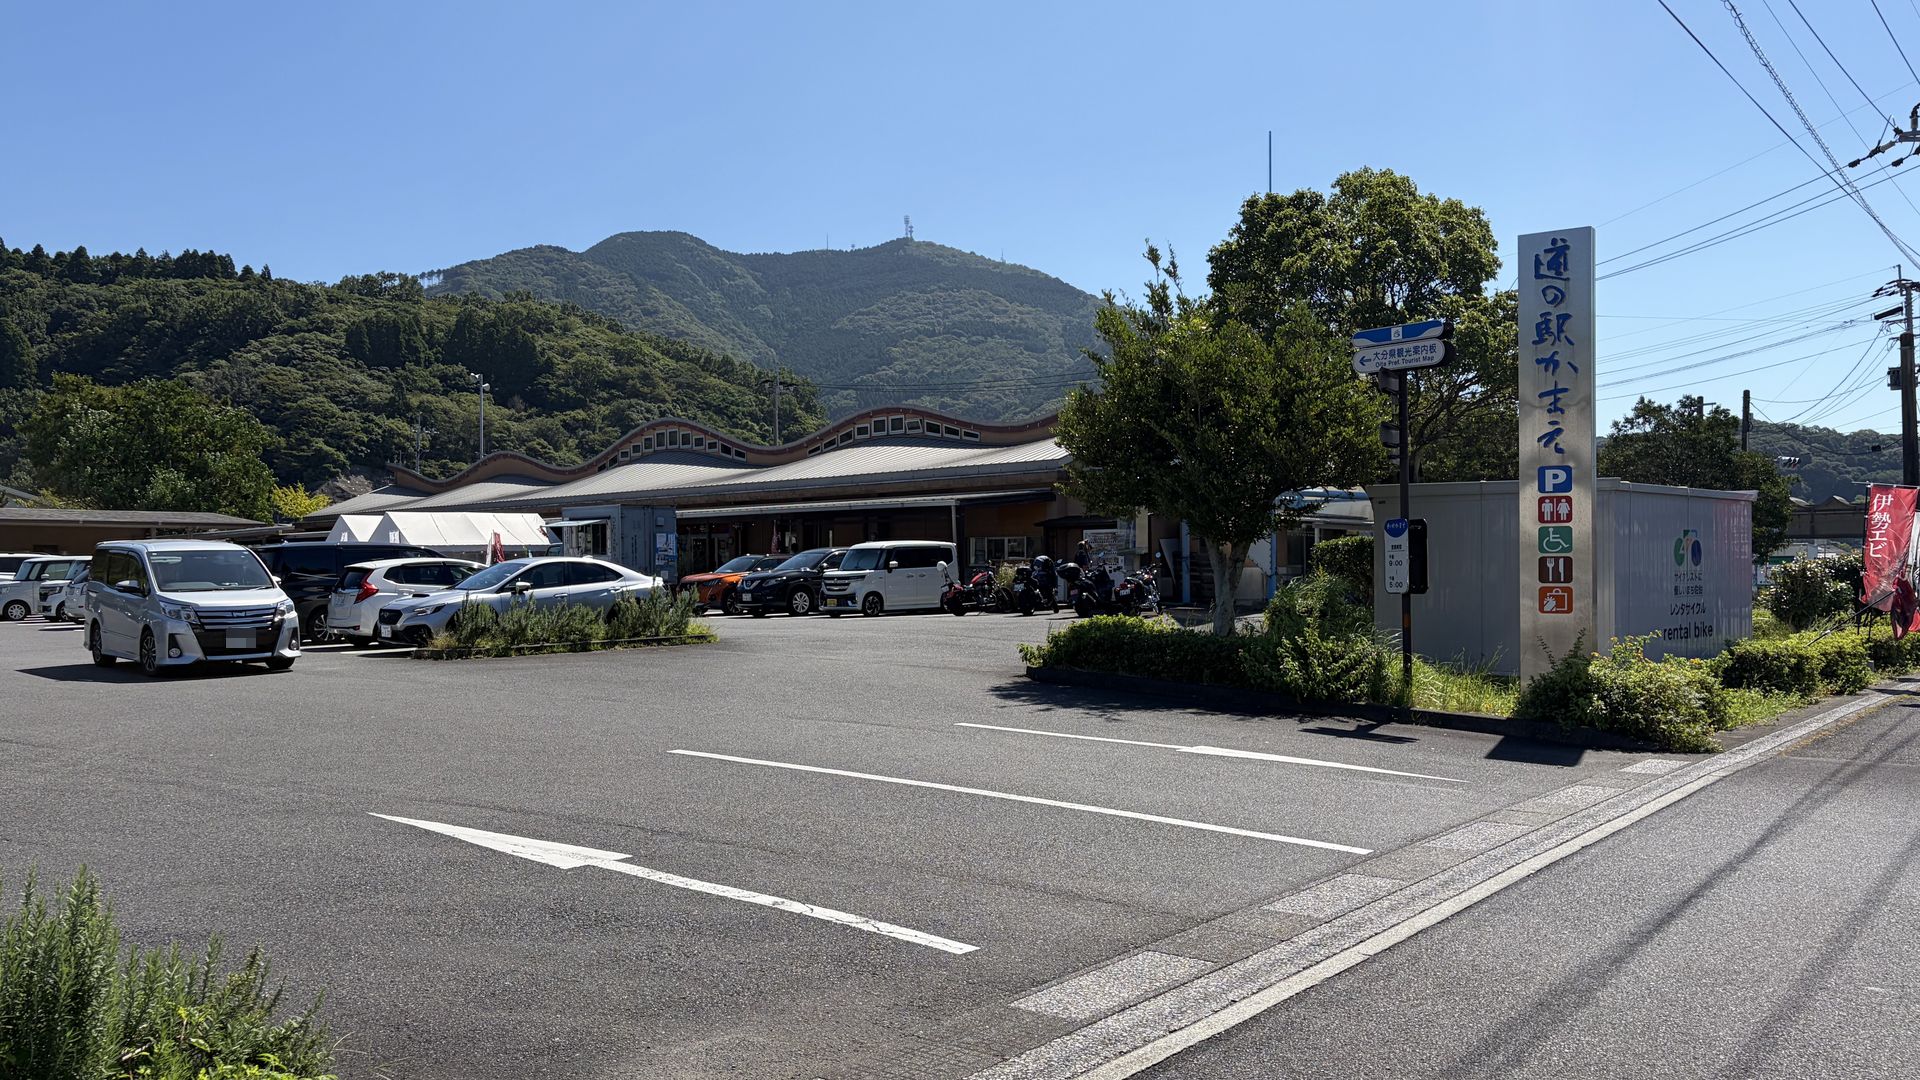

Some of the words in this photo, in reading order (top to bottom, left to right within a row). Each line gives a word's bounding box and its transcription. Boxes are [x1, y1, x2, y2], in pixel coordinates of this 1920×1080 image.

[1373, 344, 1437, 361] 大分県観光案内板
[1402, 356, 1421, 365] Tourist
[1422, 355, 1435, 363] Map
[1545, 469, 1567, 492] P
[1868, 493, 1894, 558] 伊勢エビ
[1670, 602, 1707, 616] レンタサイクル
[1663, 621, 1691, 640] rental
[1694, 621, 1713, 638] bike
